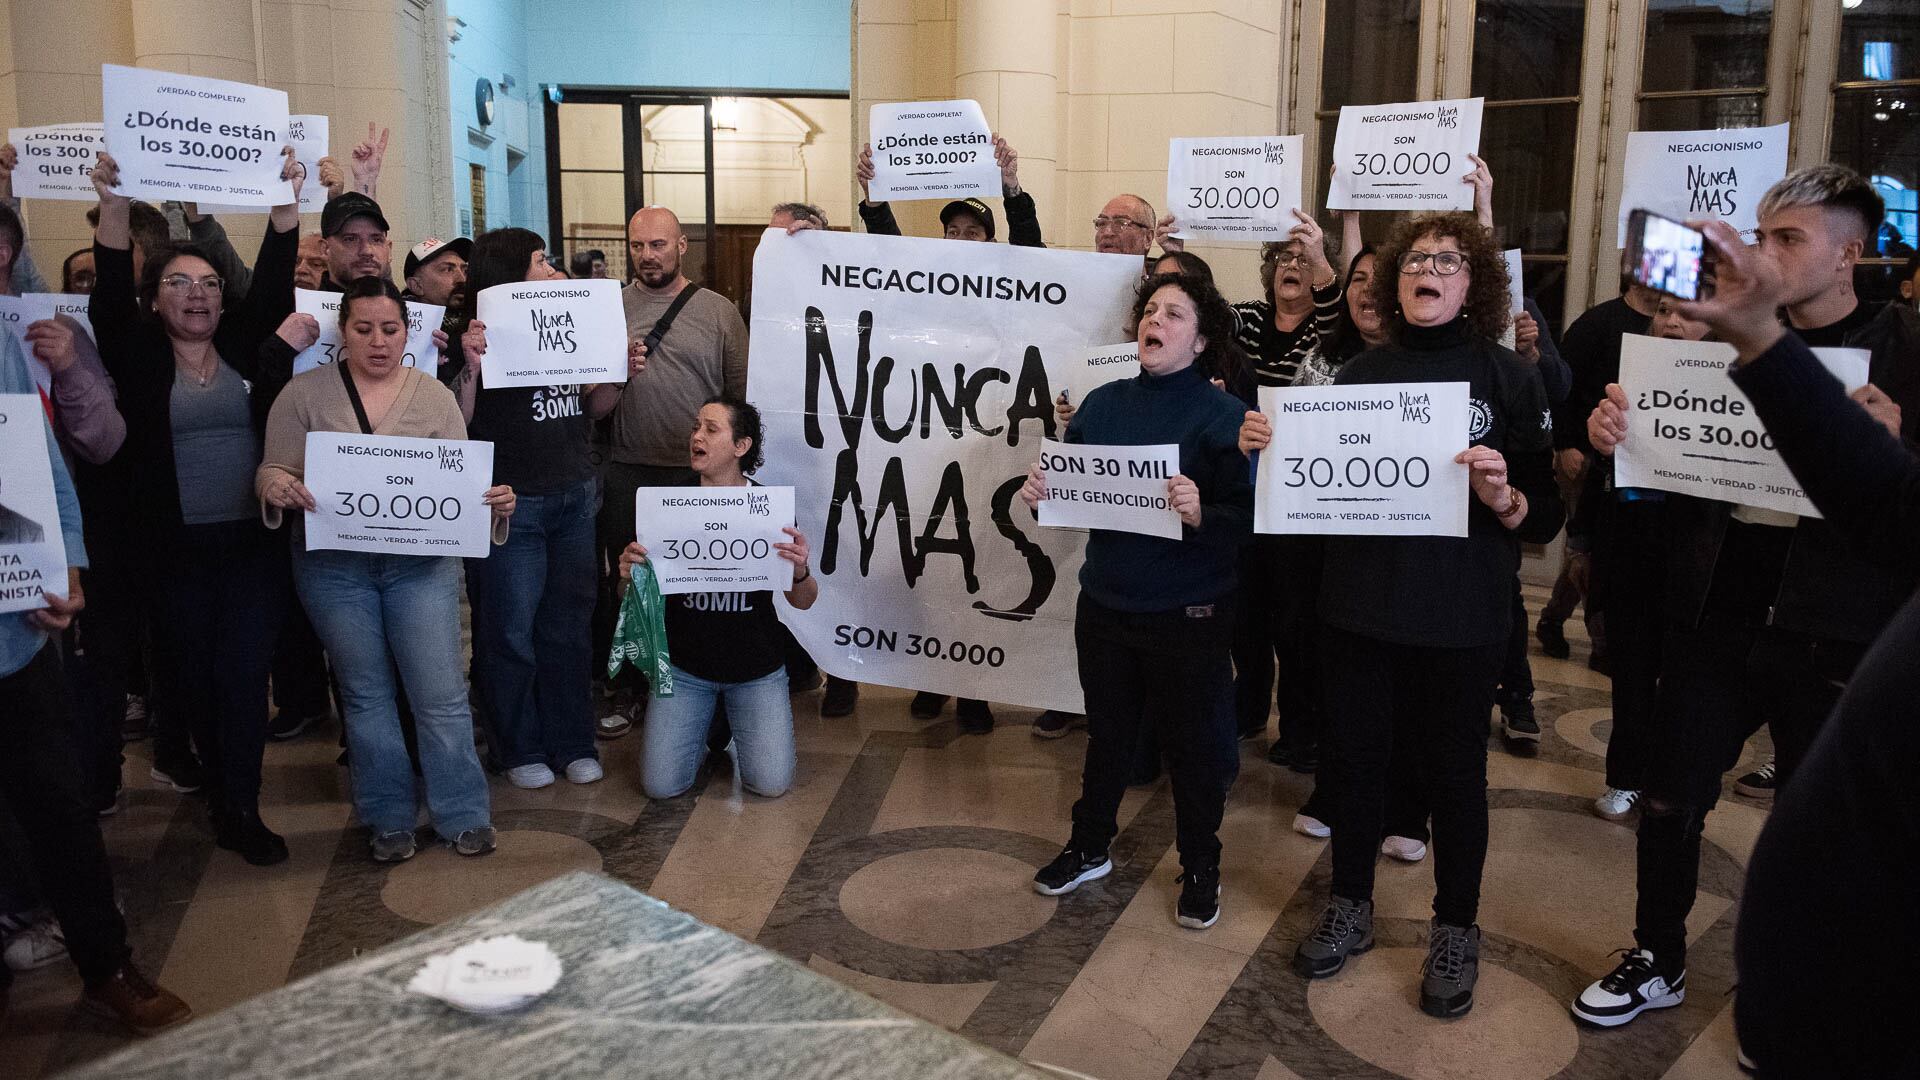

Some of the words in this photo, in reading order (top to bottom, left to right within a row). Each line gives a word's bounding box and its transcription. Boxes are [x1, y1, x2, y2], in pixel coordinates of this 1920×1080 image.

[157, 86, 196, 97] ¿VERDAD
[198, 92, 246, 104] COMPLETA?
[926, 111, 962, 119] COMPLETA?
[1362, 112, 1434, 123] NEGACIONISMO
[1437, 106, 1458, 117] NUNCA
[124, 111, 212, 134] ¿Dónde
[219, 124, 276, 142] están
[1437, 115, 1457, 129] MAS
[25, 133, 94, 142] ¿Dónde
[877, 133, 939, 151] ¿Dónde
[942, 132, 987, 145] están
[1394, 136, 1416, 145] SON
[26, 143, 51, 156] los
[56, 146, 90, 158] 300
[140, 136, 173, 153] los
[178, 140, 262, 163] 30.000?
[1192, 147, 1261, 156] NEGACIONISMO
[1264, 142, 1284, 153] NUNCA
[1668, 141, 1763, 152] NEGACIONISMO
[889, 154, 911, 167] los
[915, 151, 977, 166] 30.000?
[1265, 152, 1284, 165] MAS
[1352, 152, 1451, 175] 30.000
[39, 164, 73, 176] que
[1225, 170, 1245, 178] SON
[1687, 164, 1738, 190] NUNCA
[140, 178, 181, 188] MEMORIA
[188, 184, 222, 192] VERDAD
[229, 187, 264, 196] JUSTICIA
[1188, 187, 1279, 209] 30.000
[1689, 189, 1737, 215] MAS
[821, 263, 1067, 305] NEGACIONISMO
[512, 290, 590, 299] NEGACIONISMO
[531, 309, 575, 331] NUNCA
[538, 331, 577, 353] MAS
[1674, 359, 1725, 369] ¿VERDAD
[804, 306, 1057, 449] NUNCA
[549, 384, 581, 397] SON
[1283, 399, 1394, 413] NEGACIONISMO
[1399, 391, 1430, 407] NUNCA
[1637, 388, 1745, 416] ¿Dónde
[532, 396, 582, 422] 30MIL
[1402, 406, 1431, 424] MAS
[1339, 433, 1371, 445] SON
[1653, 419, 1691, 441] los
[1700, 425, 1777, 450] 30.00
[337, 445, 434, 459] NEGACIONISMO
[438, 446, 463, 458] NUNCA
[440, 459, 463, 472] MAS
[1039, 452, 1085, 474] SON
[1092, 458, 1120, 476] 30
[1128, 460, 1173, 479] MIL
[1284, 456, 1430, 488] 30.000
[386, 475, 414, 485] SON
[1653, 469, 1702, 482] MEMORIA
[1711, 477, 1755, 490] VERDAD
[662, 498, 744, 507] NEGACIONISMO
[747, 493, 769, 504] NUNCA
[1046, 488, 1078, 501] ¡FUE
[1082, 490, 1172, 511] GENOCIDIO!
[335, 492, 461, 521] 30.000
[749, 503, 770, 517] MAS
[1287, 512, 1331, 520] MEMORIA
[1339, 513, 1379, 521] VERDAD
[1387, 513, 1431, 521] JUSTICIA
[704, 522, 728, 531] SON
[337, 533, 377, 541] MEMORIA
[425, 538, 460, 546] JUSTICIA
[819, 449, 1057, 622] MAS
[662, 538, 769, 560] 30.000
[739, 575, 768, 583] JUSTICIA
[682, 591, 753, 612] 30MIL
[834, 624, 897, 652] SON
[905, 634, 1005, 668] 30.000
